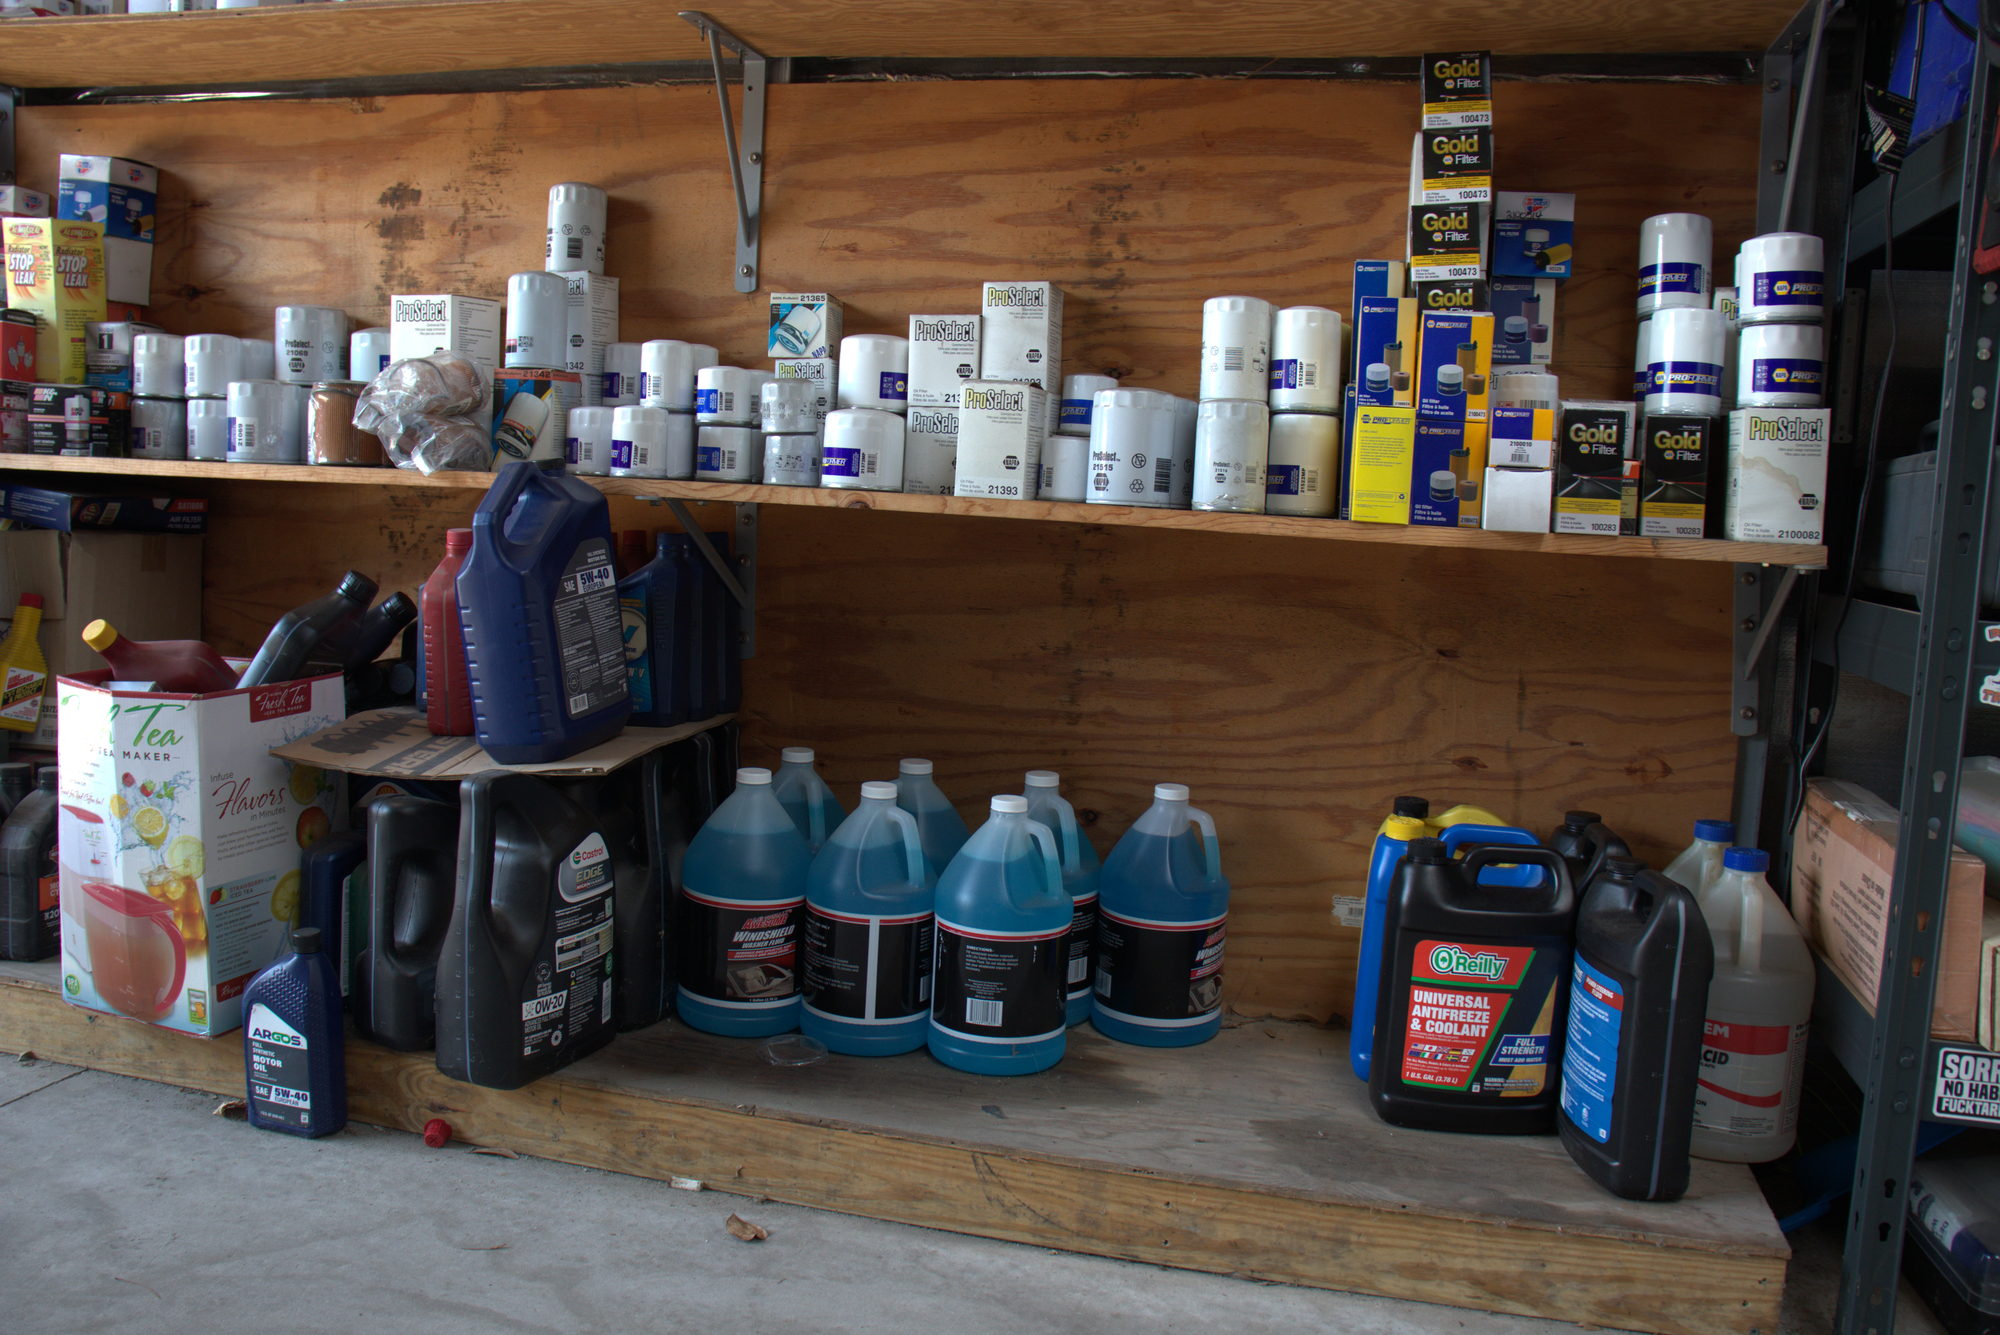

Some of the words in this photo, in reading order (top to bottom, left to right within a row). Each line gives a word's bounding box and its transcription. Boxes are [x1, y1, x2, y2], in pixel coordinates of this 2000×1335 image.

[1434, 59, 1481, 78] Gold
[1460, 114, 1490, 124] 100473
[1432, 135, 1479, 154] Gold
[1458, 190, 1488, 199] 100473
[1422, 212, 1468, 231] Gold
[9, 254, 34, 270] STOP
[57, 256, 88, 273] STOP
[15, 271, 35, 285] LEAK
[64, 274, 88, 287] LEAK
[1448, 267, 1477, 277] 100473
[988, 286, 1044, 307] ProSelect
[1427, 288, 1473, 307] Gold
[396, 300, 446, 322] ProSelect
[915, 320, 974, 342] ProSelect
[812, 346, 827, 358] NAPA
[779, 362, 824, 379] ProSelect
[965, 388, 1023, 411] ProSelect
[912, 412, 958, 434] ProSele
[1750, 416, 1823, 441] ProSelect
[1569, 423, 1618, 443] Gold
[1654, 430, 1701, 450] Gold
[1092, 451, 1117, 462] ProSelect
[988, 485, 1018, 496] 21393
[1778, 530, 1820, 540] 2100082
[564, 580, 576, 593] SAE
[580, 568, 609, 586] 5W-40
[583, 582, 605, 593] EUROPEAN
[256, 688, 289, 711] Fresh
[289, 684, 307, 705] Tea
[124, 703, 185, 748] Tea
[122, 751, 171, 762] MAKER
[210, 770, 234, 782] Infuse
[212, 778, 287, 819] Flavors
[250, 813, 257, 822] in
[258, 807, 286, 820] Minutes
[582, 846, 604, 861] Castrol
[576, 864, 604, 882] EDGE
[733, 924, 796, 942] WINDSHIELD
[1431, 946, 1507, 980] O'Reilly
[535, 994, 564, 1014] 0W-20
[1414, 989, 1491, 1009] UNIVERSAL
[1411, 1004, 1490, 1023] ANTIFREEZE
[1410, 1018, 1422, 1031] &
[1425, 1020, 1489, 1037] COOLANT
[252, 1028, 301, 1046] ARGOS
[252, 1041, 263, 1049] FULL
[1515, 1038, 1536, 1046] FULL
[1501, 1046, 1545, 1055] STRENGTH
[1700, 1049, 1729, 1065] CID
[253, 1054, 282, 1068] MOTOR
[253, 1063, 267, 1072] OIL
[255, 1085, 269, 1096] SAE
[274, 1087, 308, 1102] 5W-40
[1943, 1080, 1964, 1097] NO
[1968, 1082, 1999, 1101] HAB
[275, 1096, 299, 1106] EUROPEAN
[1941, 1098, 2000, 1118] FUCKTAR
